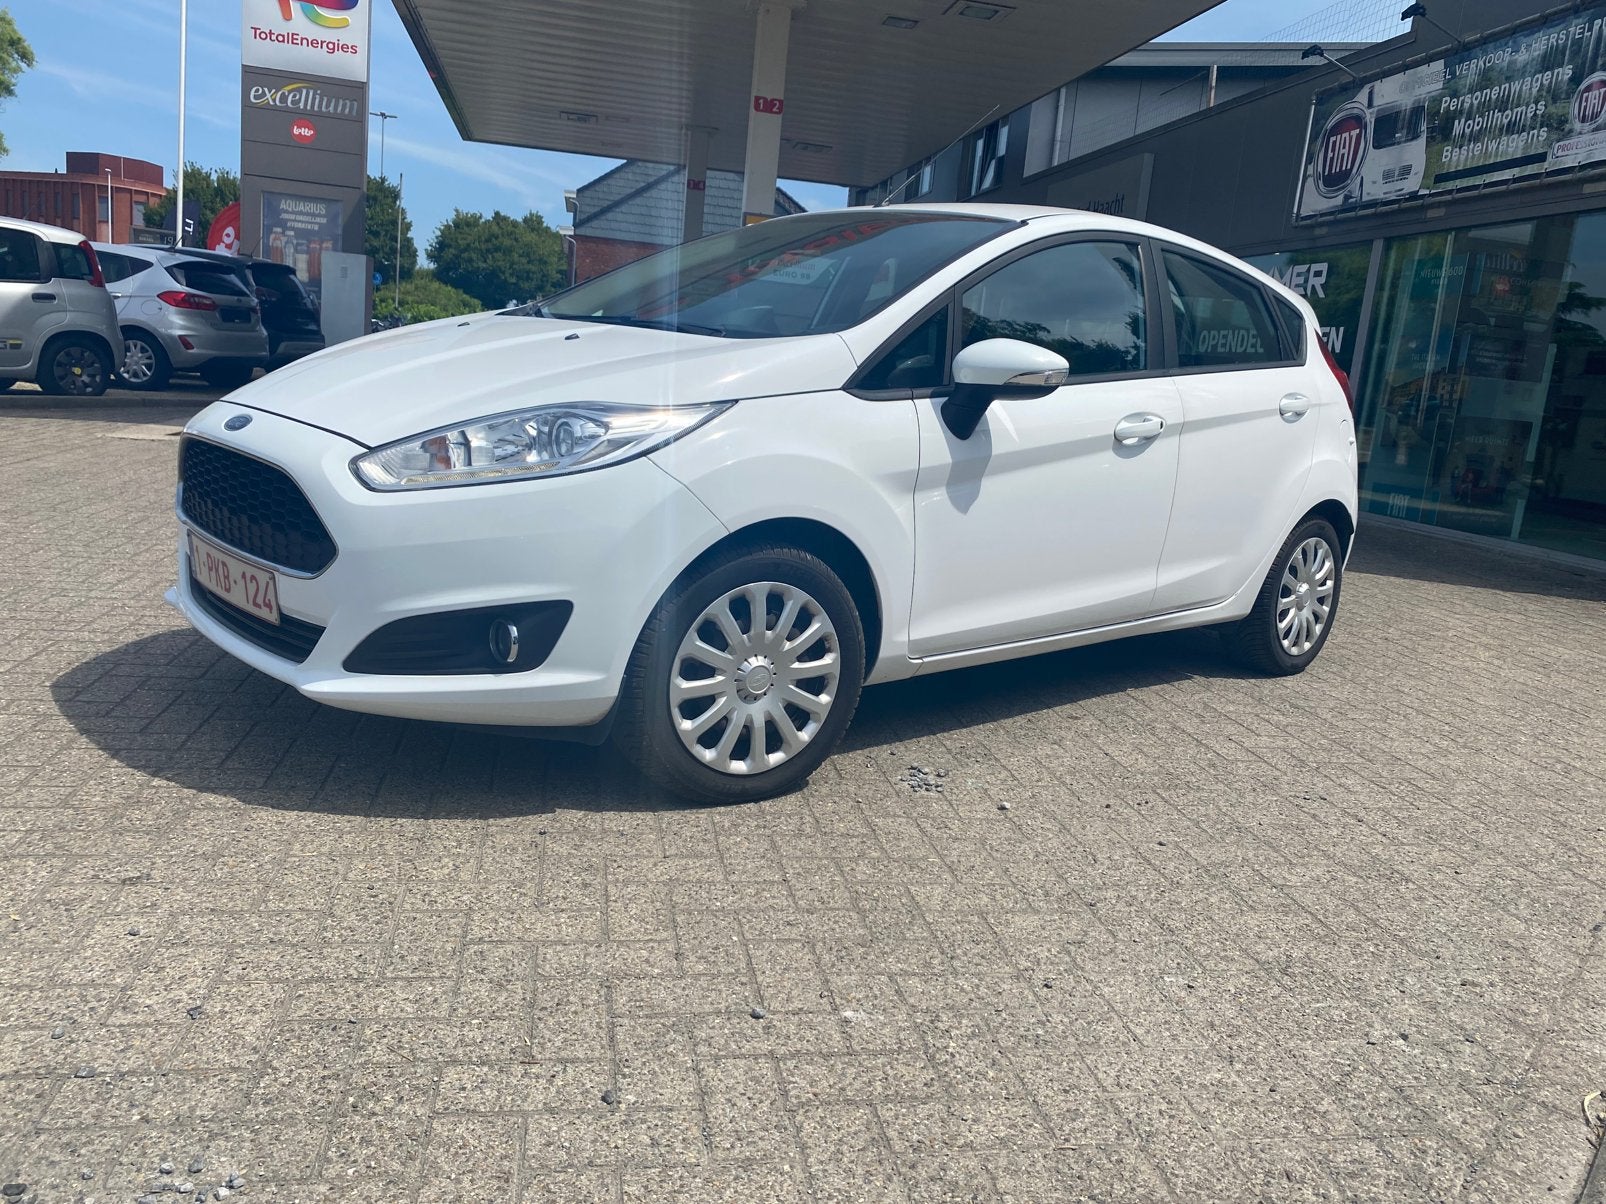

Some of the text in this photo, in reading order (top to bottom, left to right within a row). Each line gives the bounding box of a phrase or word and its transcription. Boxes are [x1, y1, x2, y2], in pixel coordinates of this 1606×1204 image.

[251, 26, 358, 54] TotalEnergies
[250, 83, 358, 116] excellium
[1441, 64, 1573, 112] Personenwagens
[758, 98, 780, 112] 1 2
[1452, 100, 1546, 136] Mobilhomes
[293, 125, 314, 136] lotto
[1442, 127, 1548, 162] Bestelwagens
[1325, 128, 1360, 177] FIAT
[280, 199, 326, 215] AQUARIUS
